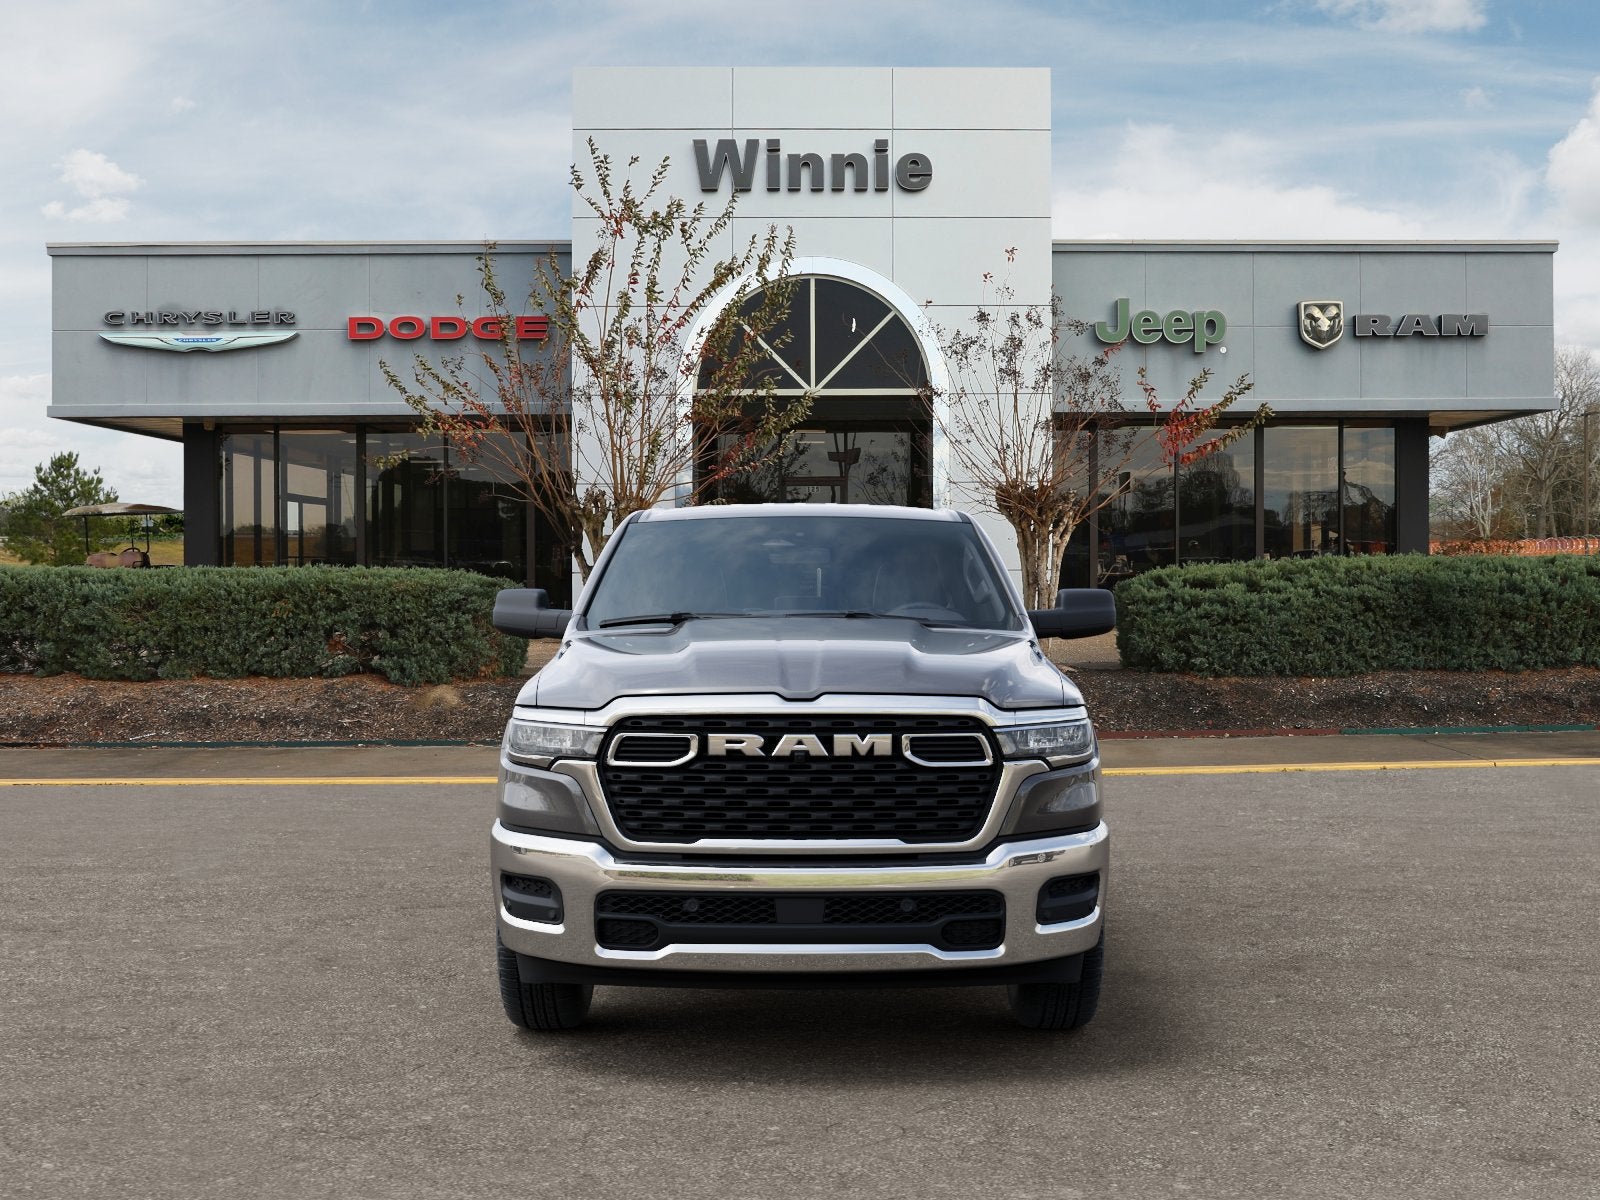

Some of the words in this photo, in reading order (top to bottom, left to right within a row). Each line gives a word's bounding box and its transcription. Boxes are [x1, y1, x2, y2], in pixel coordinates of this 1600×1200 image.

[692, 138, 933, 191] Winnie
[103, 310, 297, 326] CHRYSLER
[347, 315, 549, 340] DODGE
[1095, 297, 1227, 353] Jeep
[1354, 313, 1489, 337] RAM
[707, 733, 893, 757] RAM
